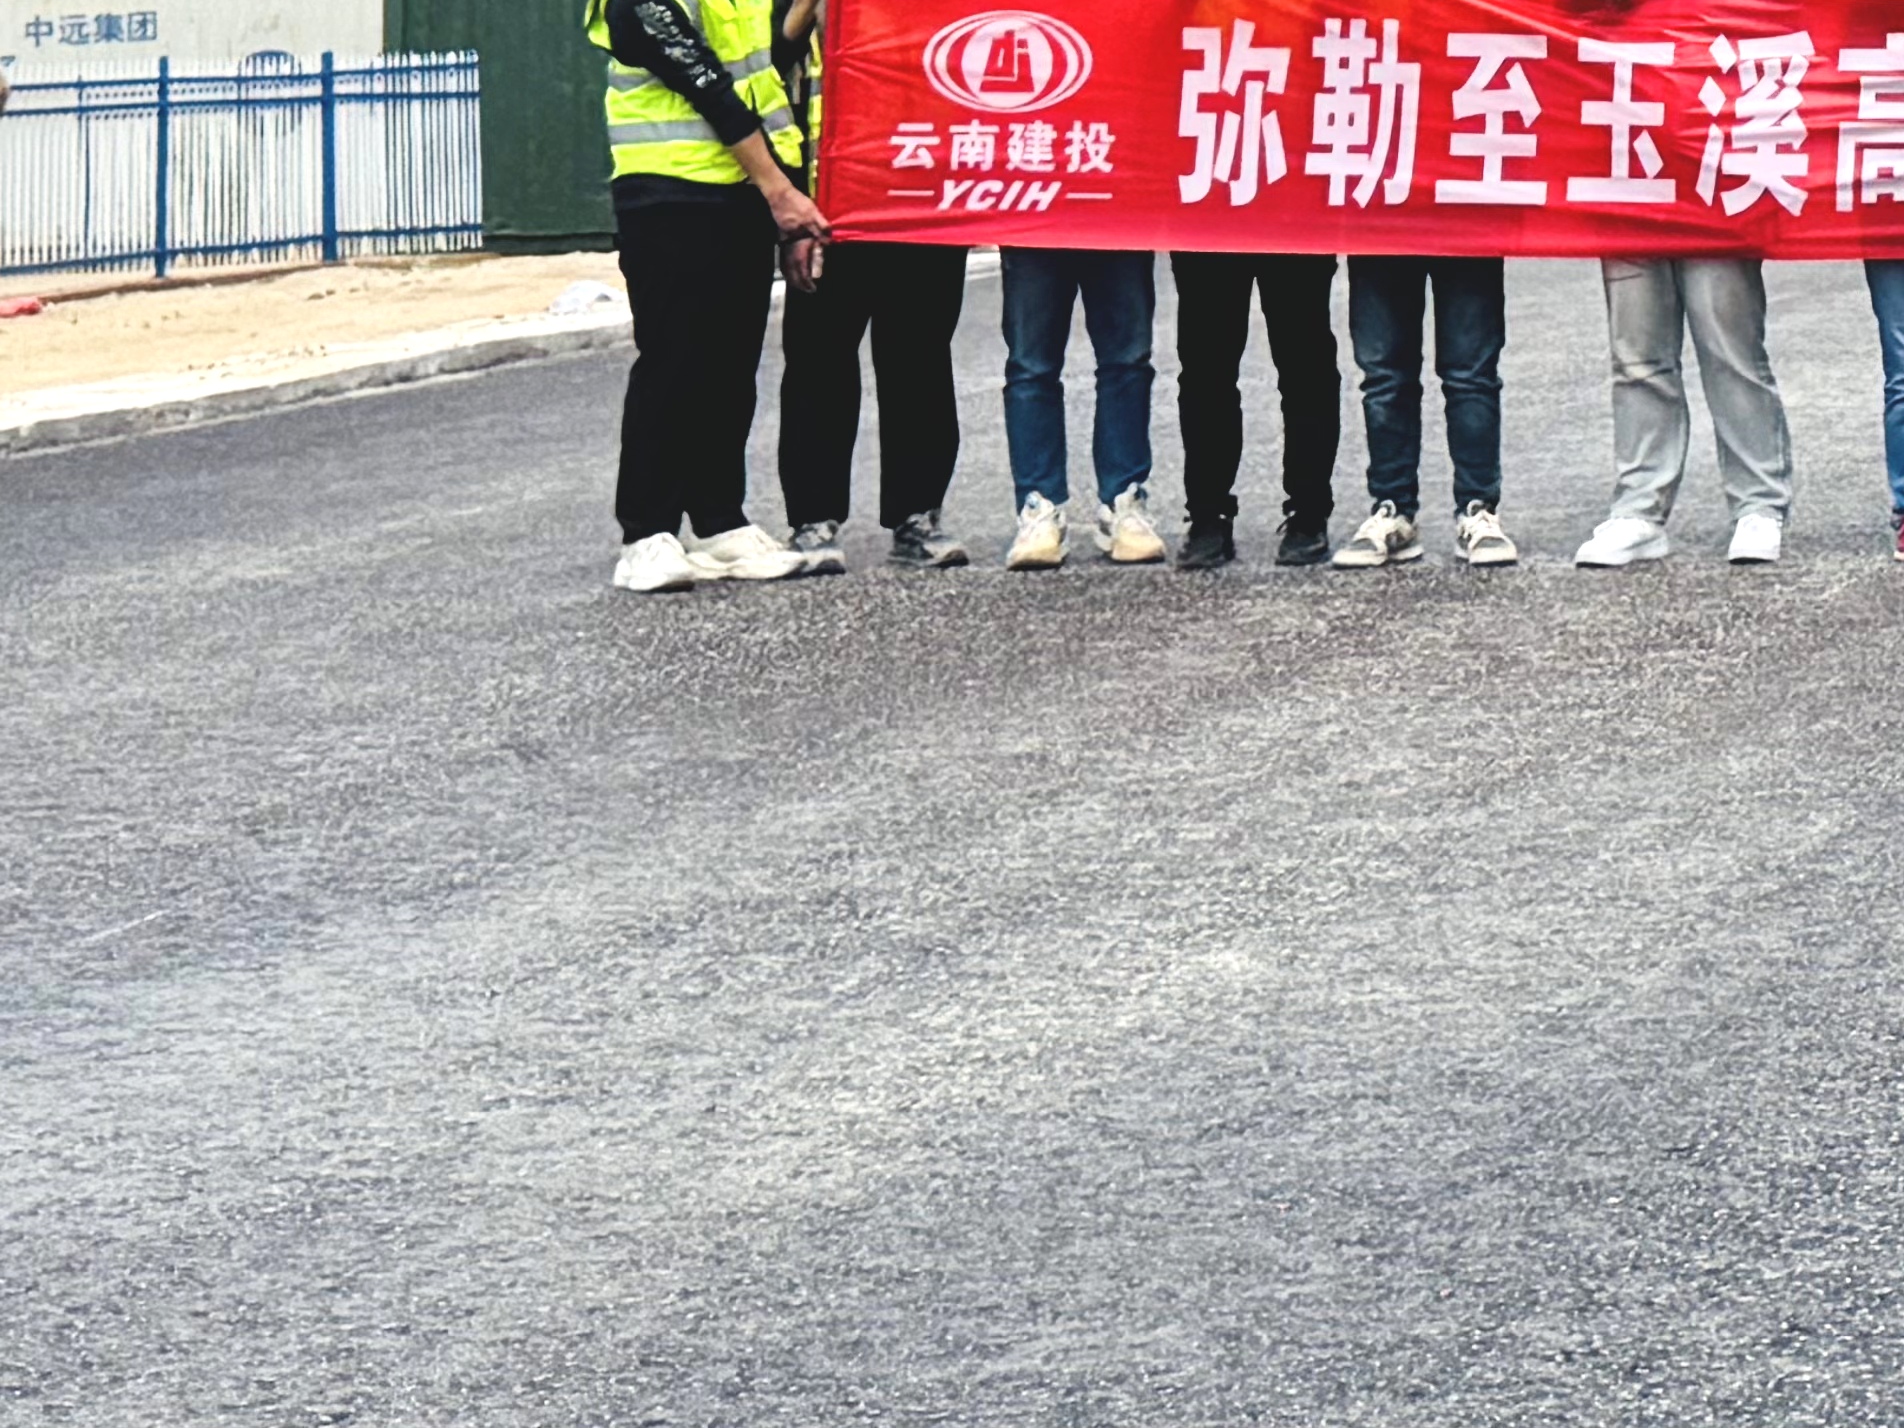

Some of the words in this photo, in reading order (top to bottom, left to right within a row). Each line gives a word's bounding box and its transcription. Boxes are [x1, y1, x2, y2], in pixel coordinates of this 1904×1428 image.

[25, 11, 158, 48] 中远集团
[888, 118, 1116, 173] 云南建投
[936, 179, 1063, 212] YCIH
